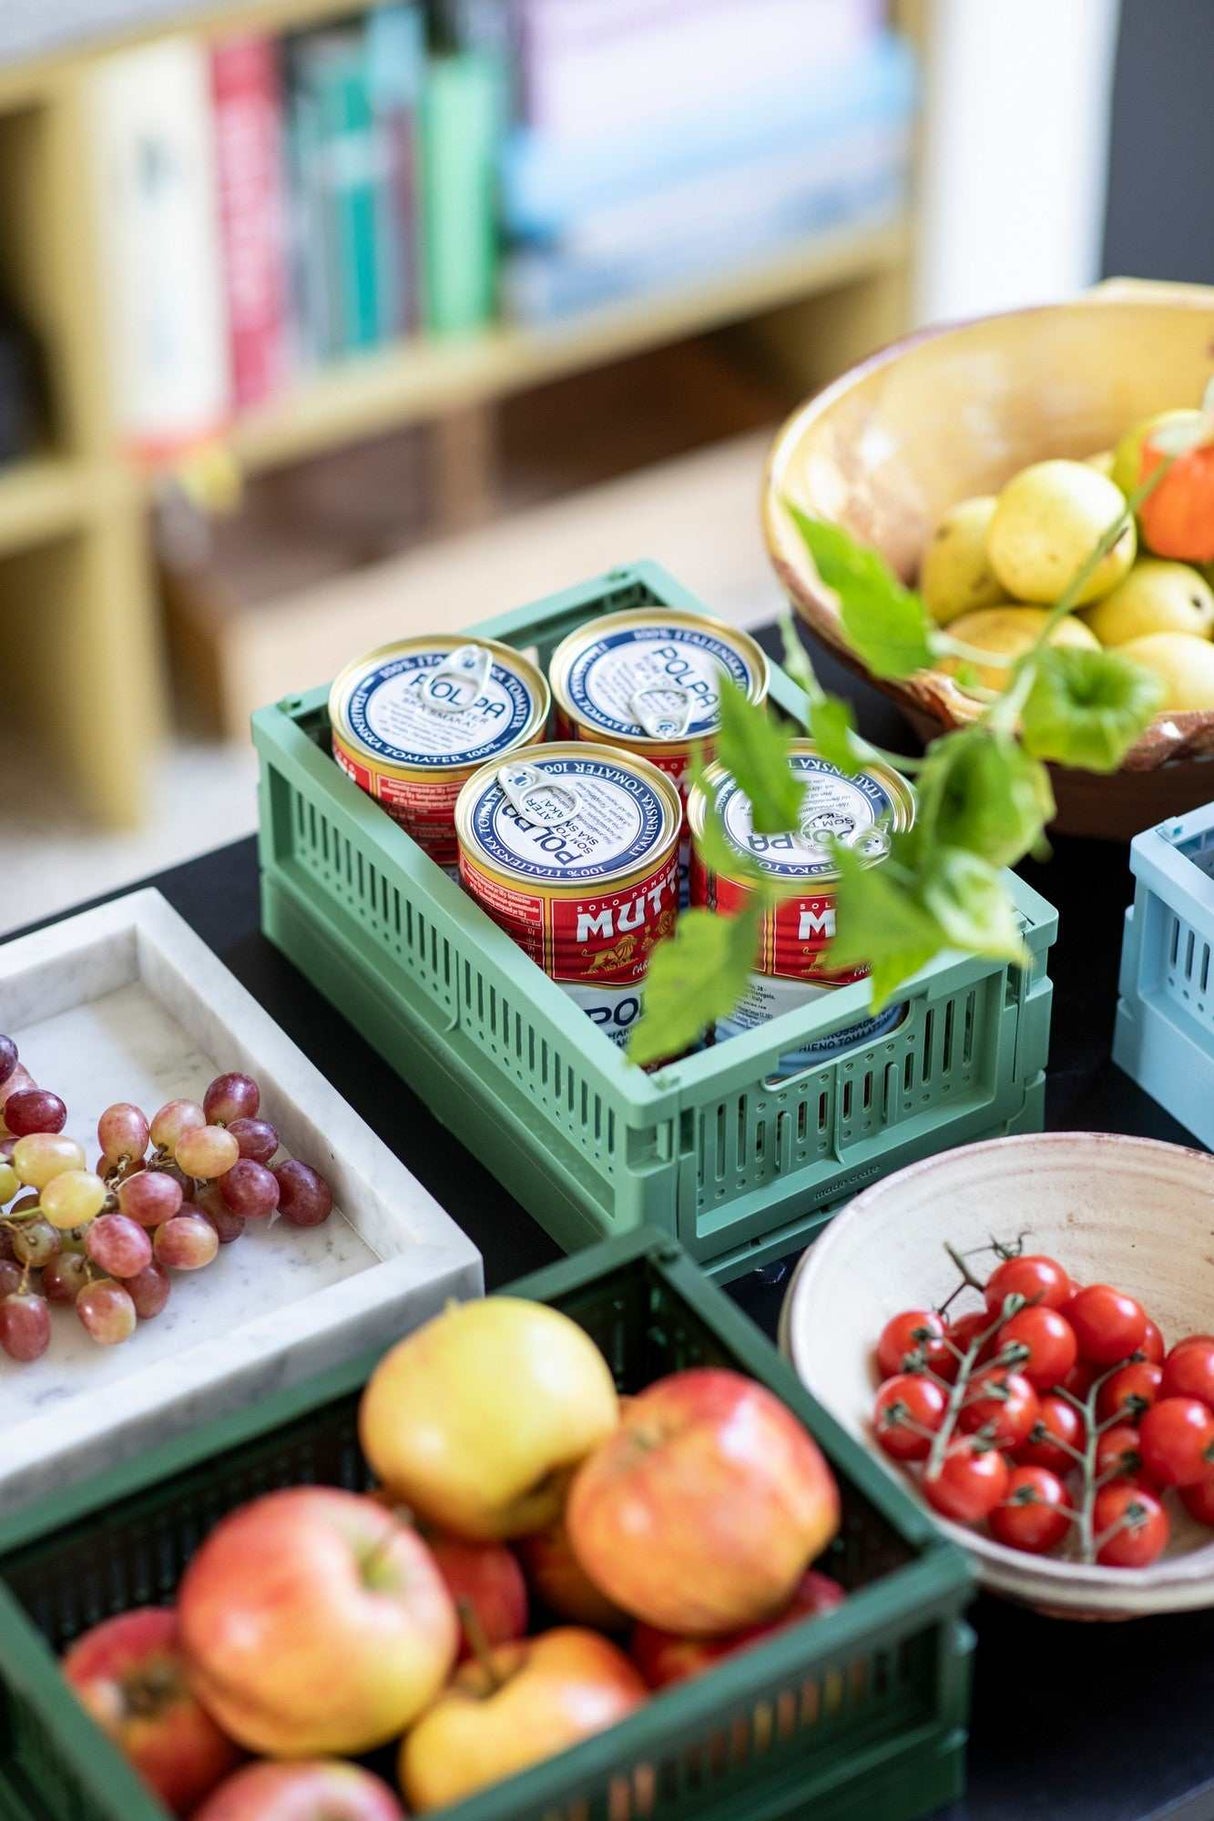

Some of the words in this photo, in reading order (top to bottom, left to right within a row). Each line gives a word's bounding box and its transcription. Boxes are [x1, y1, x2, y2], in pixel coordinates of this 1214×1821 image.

[652, 646, 718, 708] POLPA
[385, 746, 462, 764] TOMATER
[544, 763, 569, 773] 100
[575, 762, 643, 797] TOMATER
[629, 793, 659, 856] ITALIENSKA
[569, 837, 594, 855] SOM
[484, 836, 562, 877] ITALIENSKA
[577, 899, 620, 912] SOLO
[800, 902, 837, 910] SOL
